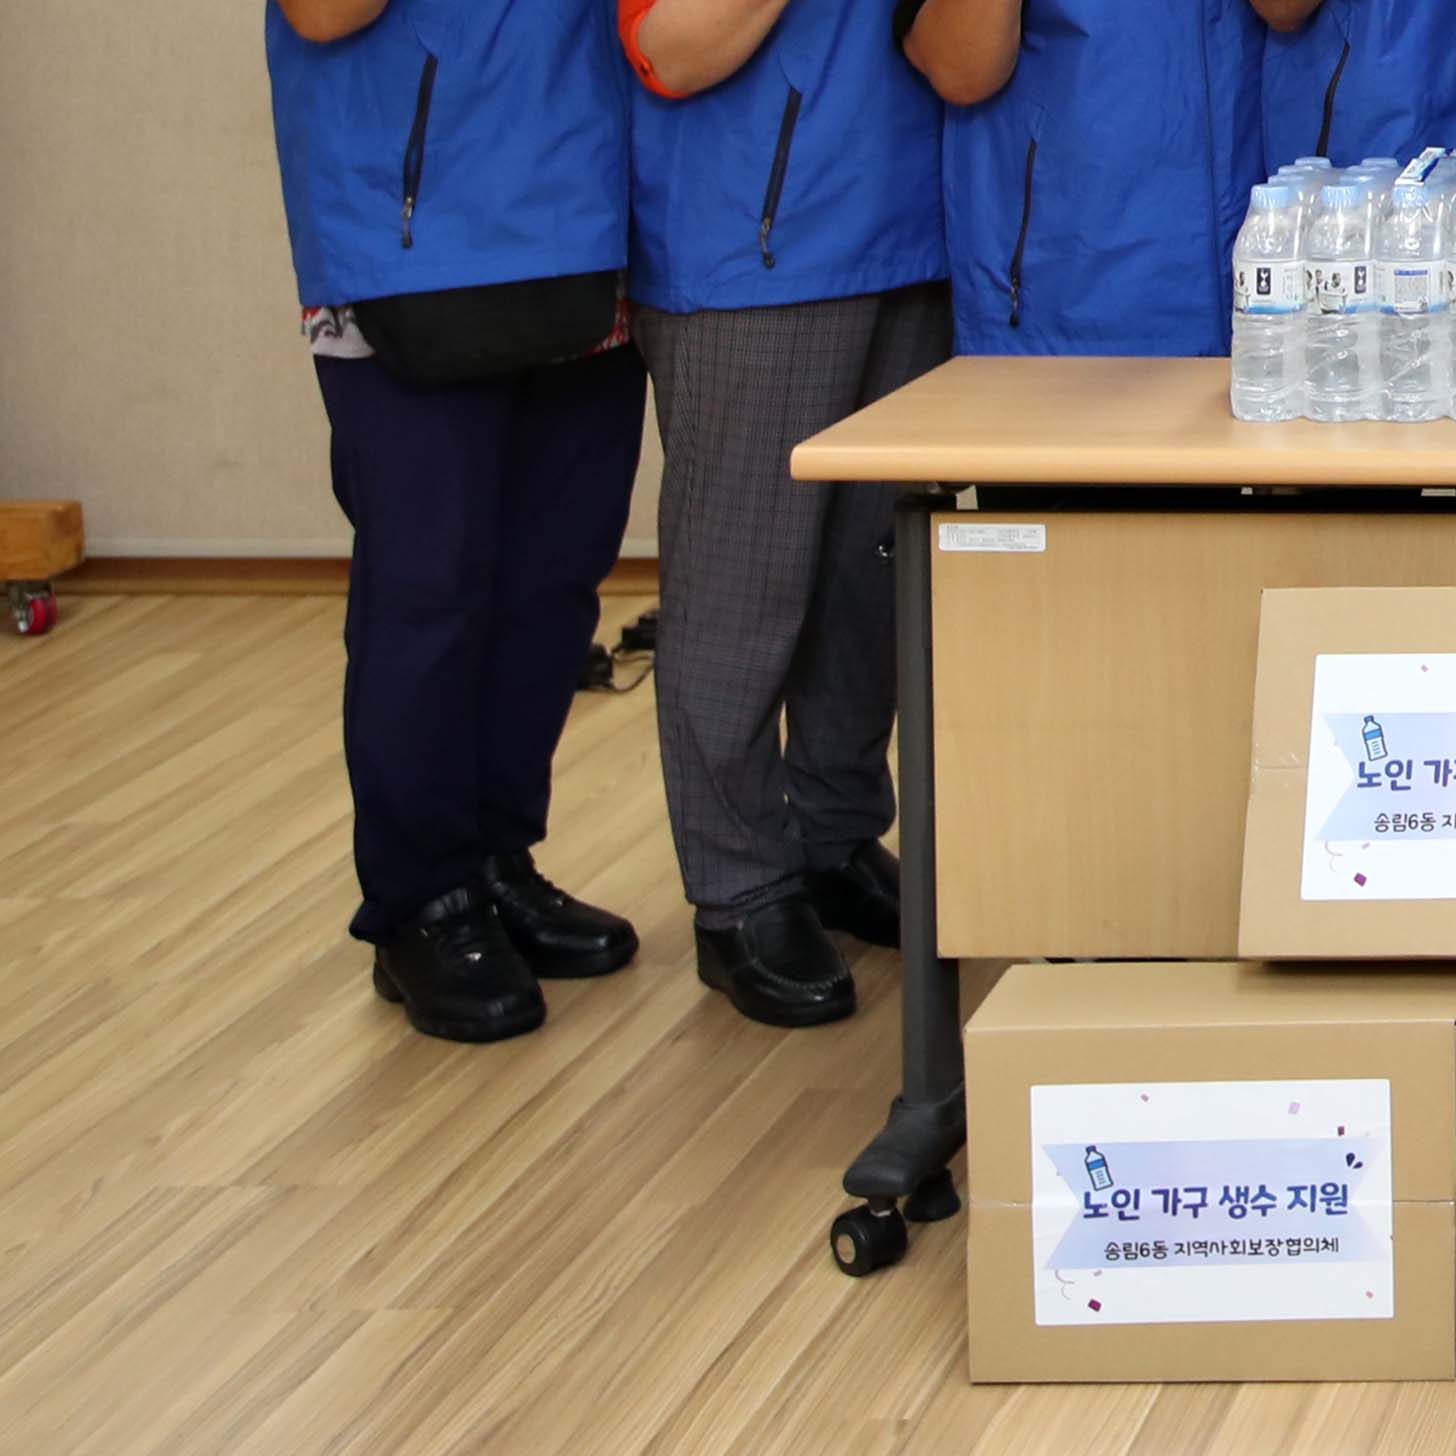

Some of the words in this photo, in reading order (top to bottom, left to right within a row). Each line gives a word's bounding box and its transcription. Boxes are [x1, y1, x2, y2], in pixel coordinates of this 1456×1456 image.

[1358, 761, 1412, 790] 노인
[1375, 812, 1436, 833] 송림6동
[1083, 1189, 1140, 1221] 노인
[1152, 1187, 1208, 1218] 가구
[1219, 1185, 1276, 1220] 생수
[1287, 1183, 1348, 1216] 지원
[1104, 1241, 1168, 1261] 송림6동
[1175, 1237, 1338, 1257] 지역사회보장협의체
